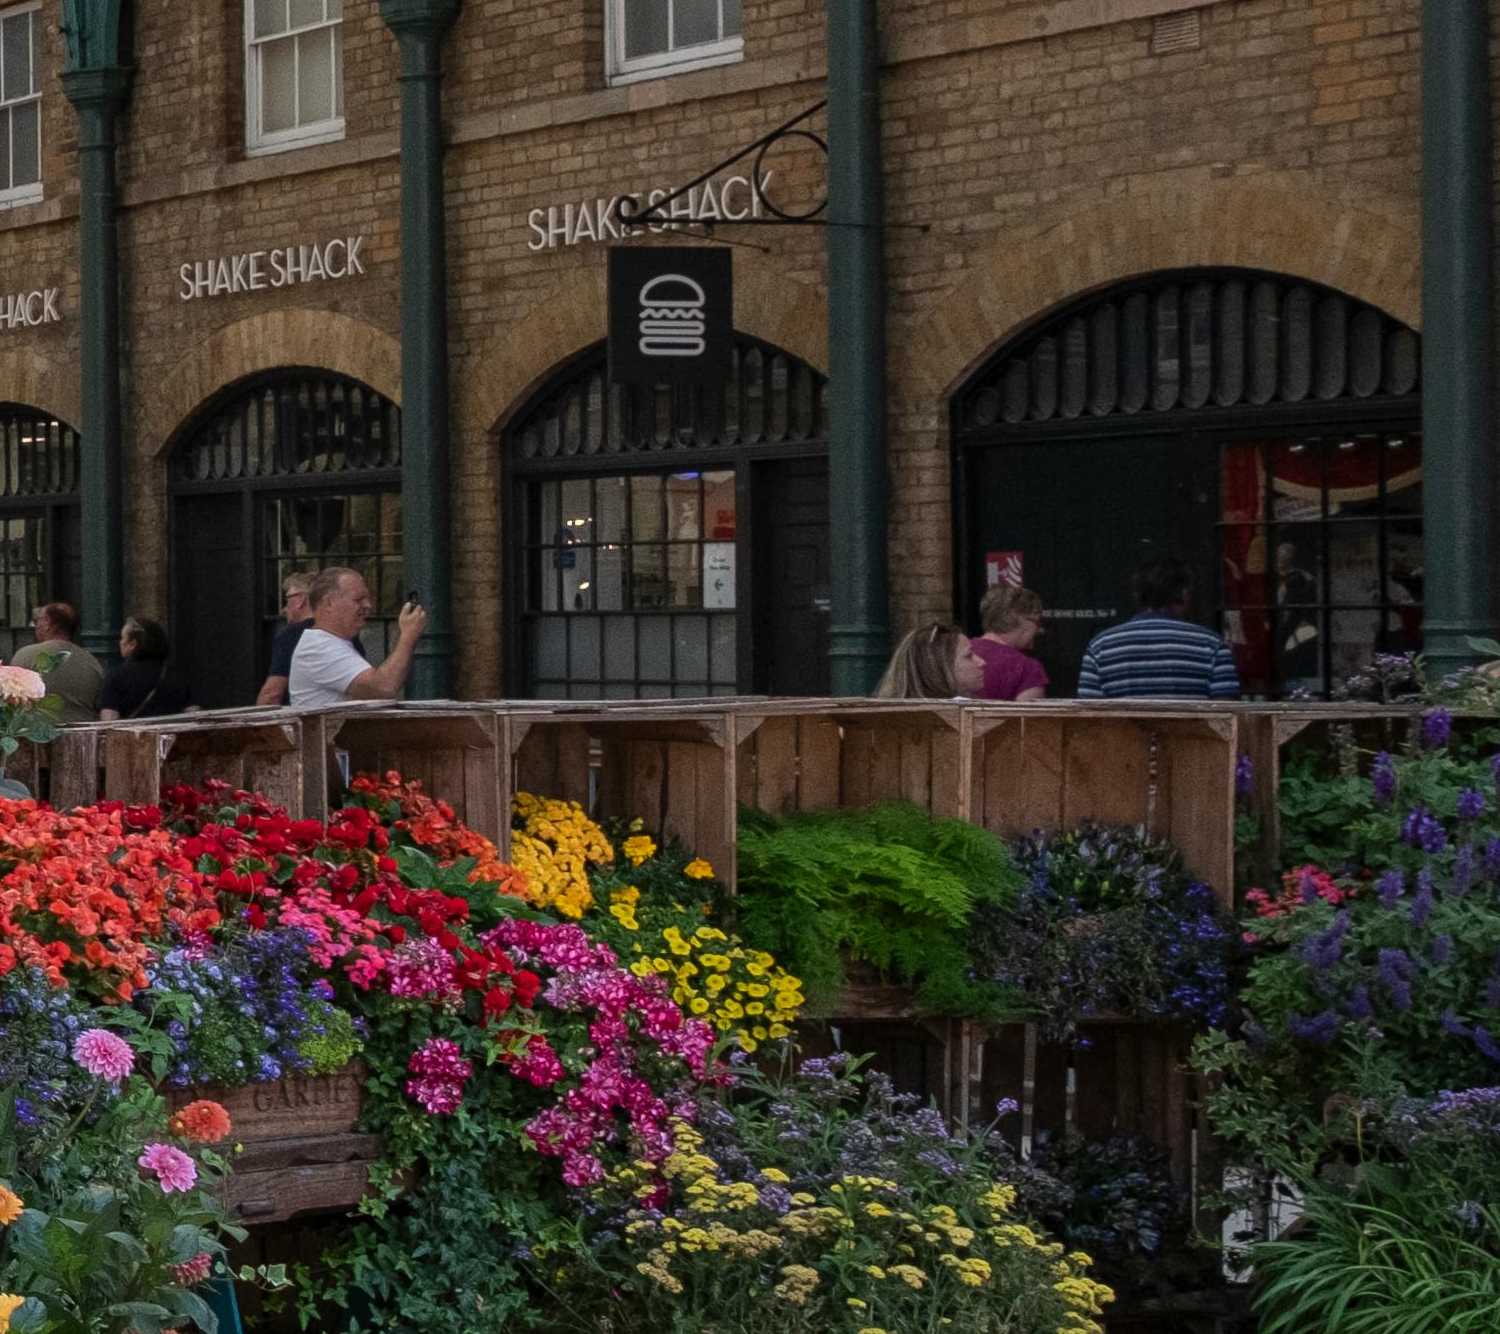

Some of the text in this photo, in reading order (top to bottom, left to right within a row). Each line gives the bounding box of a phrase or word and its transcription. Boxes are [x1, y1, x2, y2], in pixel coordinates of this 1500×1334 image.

[648, 170, 773, 232] SHACK
[179, 235, 365, 301] SHAKE SHACK
